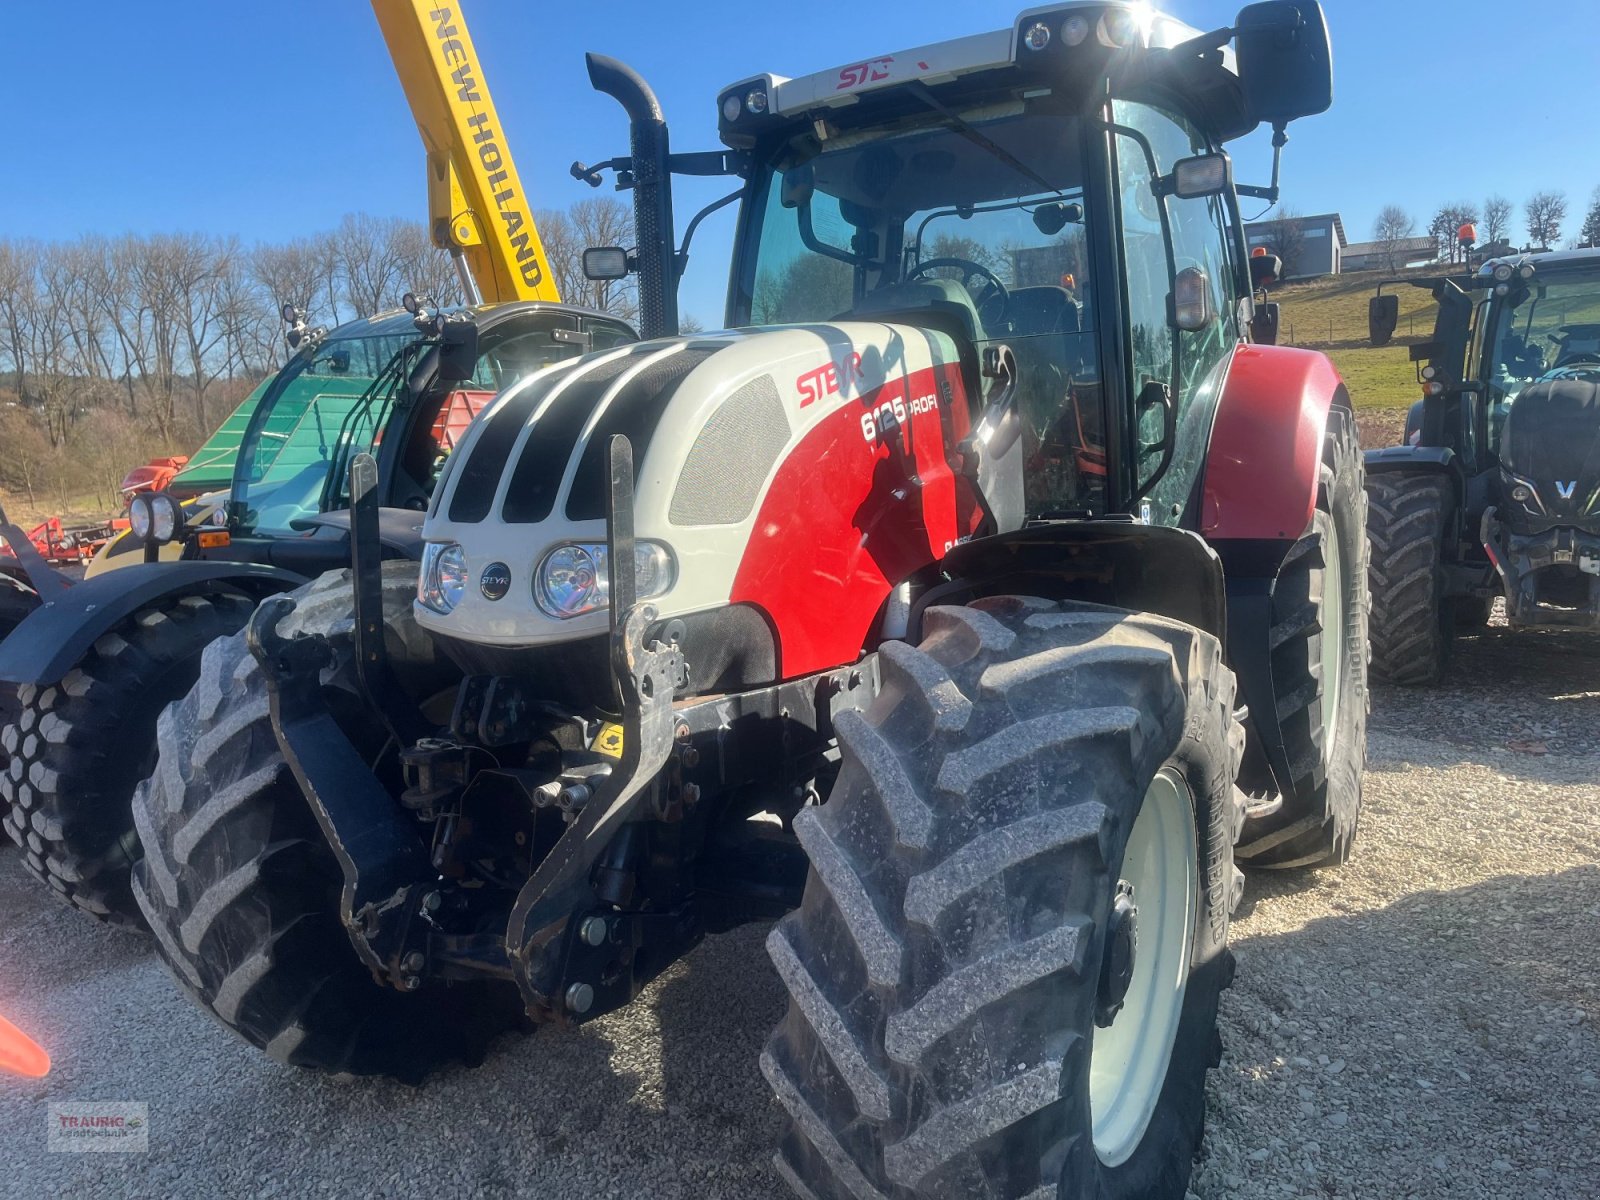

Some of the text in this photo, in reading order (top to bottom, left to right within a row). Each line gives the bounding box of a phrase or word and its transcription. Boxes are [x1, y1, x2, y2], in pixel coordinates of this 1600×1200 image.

[429, 7, 543, 288] NEW HOLLAND
[796, 351, 865, 409] STEYR
[861, 393, 939, 443] 6125 PROFI
[481, 576, 508, 585] STEYR
[1206, 762, 1226, 945] TRELLEBORG
